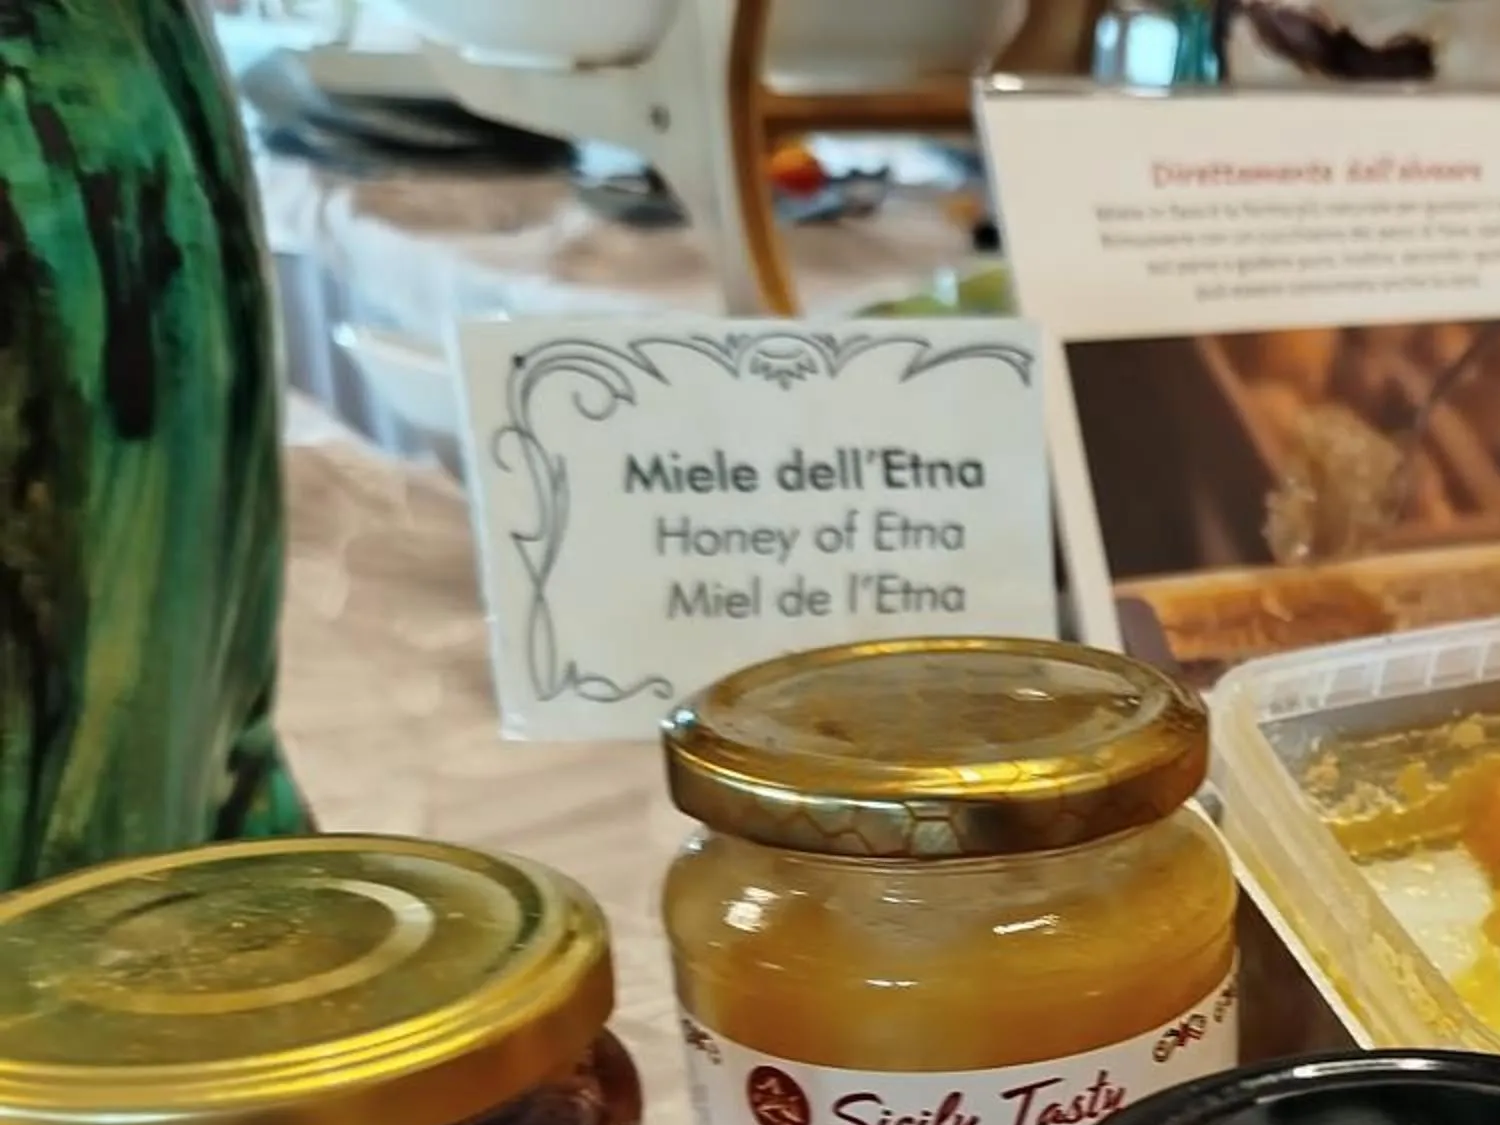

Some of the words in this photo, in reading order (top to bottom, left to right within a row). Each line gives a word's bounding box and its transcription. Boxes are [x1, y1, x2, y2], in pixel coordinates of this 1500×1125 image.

[624, 449, 760, 494] Miele
[774, 448, 985, 492] dell'Etna
[655, 514, 800, 566] Honey
[813, 508, 860, 554] of
[874, 510, 966, 553] Etna
[665, 574, 762, 620] Miel
[776, 574, 833, 617] de
[849, 572, 967, 615] l'Etna
